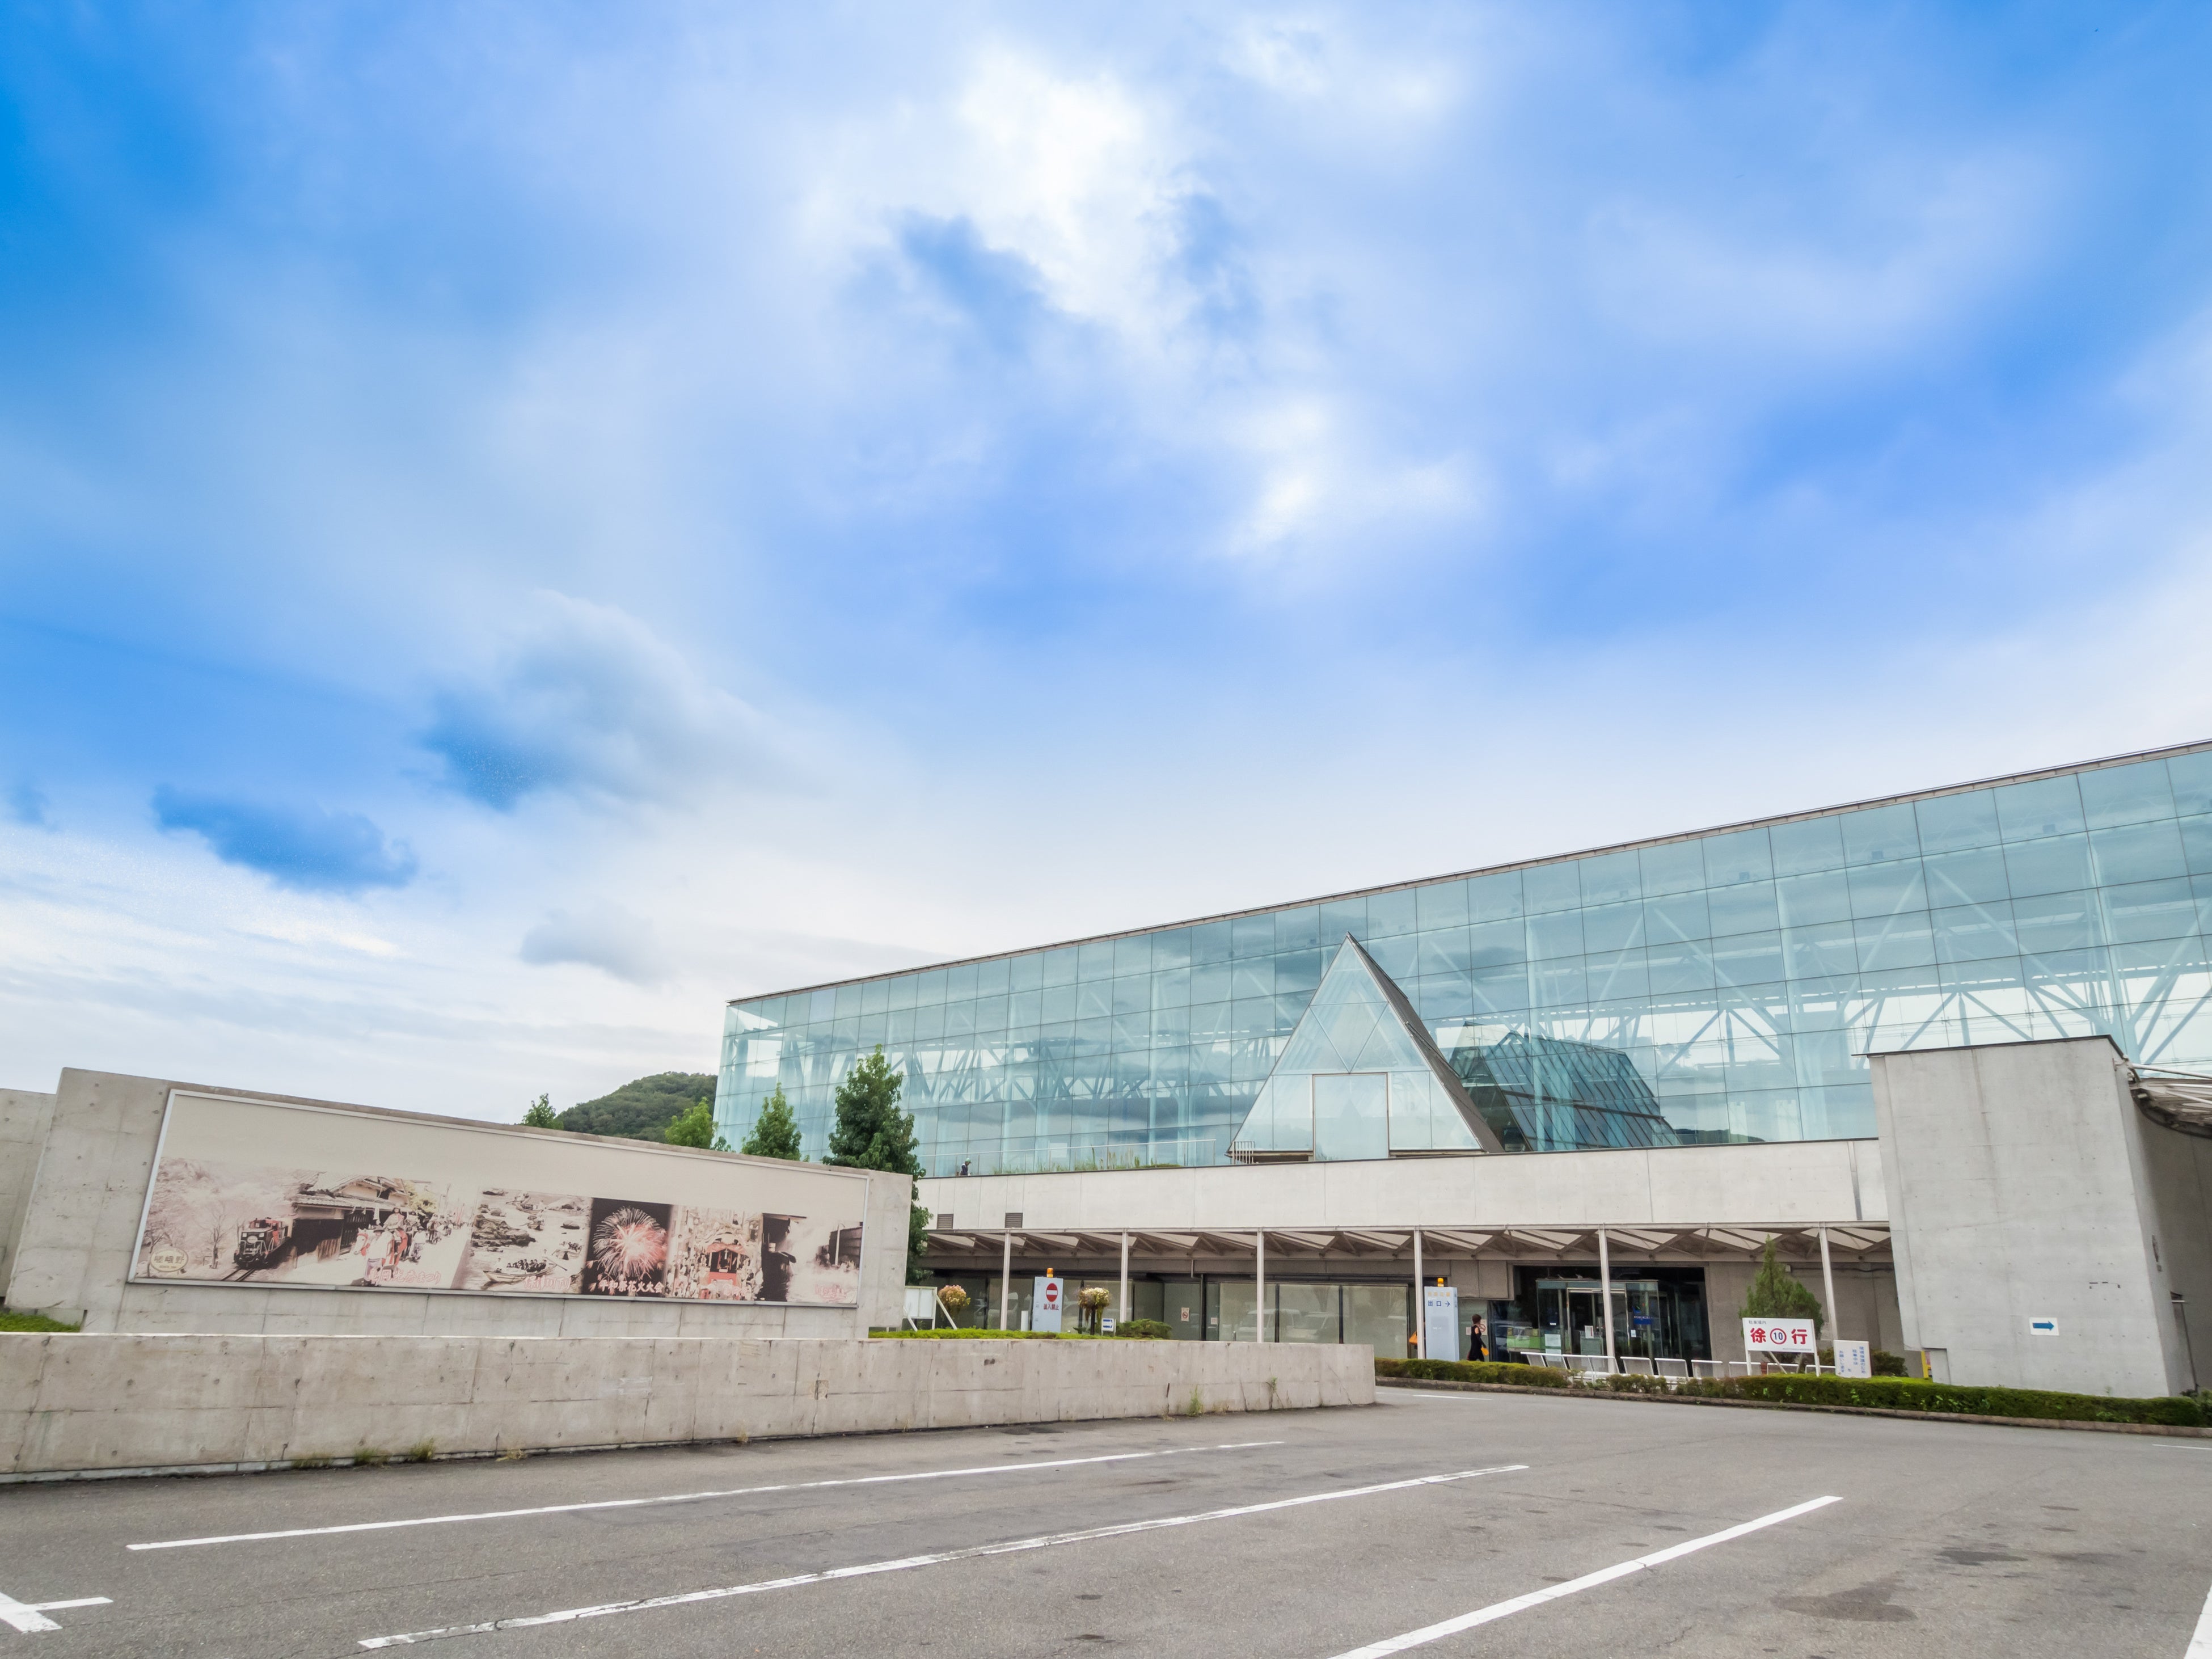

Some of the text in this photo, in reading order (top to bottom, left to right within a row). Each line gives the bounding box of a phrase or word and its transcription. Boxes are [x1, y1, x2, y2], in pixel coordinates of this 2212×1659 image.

[598, 1279, 665, 1294] 平和祭花火大会
[1773, 1332, 1783, 1340] 10
